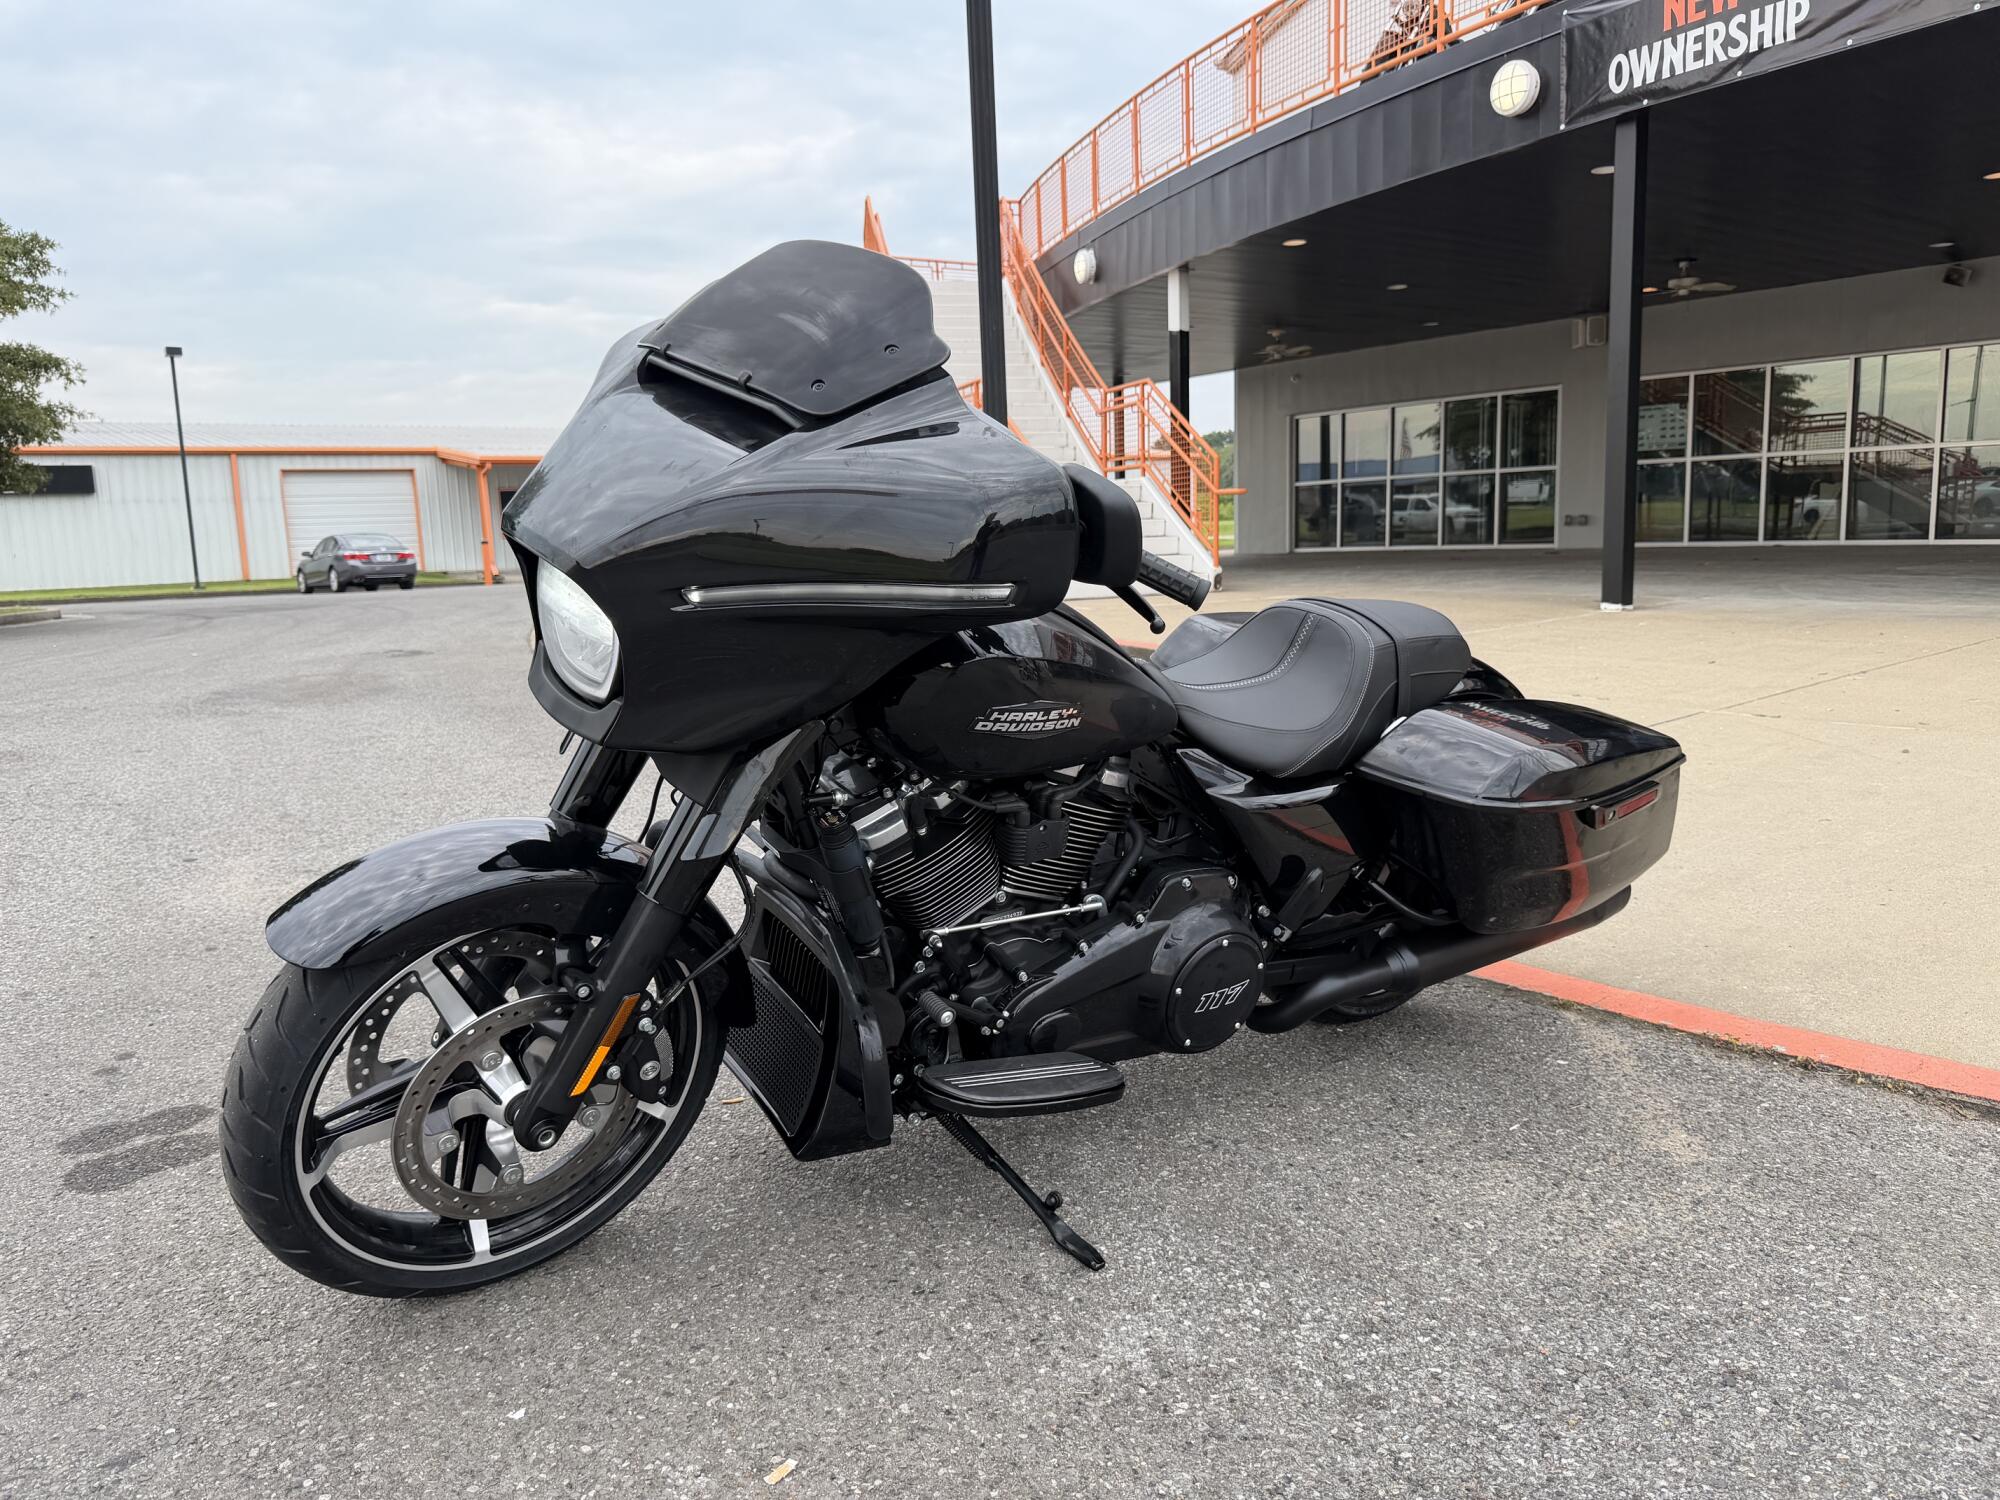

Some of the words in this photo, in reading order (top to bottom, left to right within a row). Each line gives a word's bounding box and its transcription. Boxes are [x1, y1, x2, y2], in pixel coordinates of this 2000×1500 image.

[1608, 0, 1810, 95] OWNERSHIP
[974, 717, 1082, 732] DAVIDSON
[1194, 978, 1250, 1014] 117
